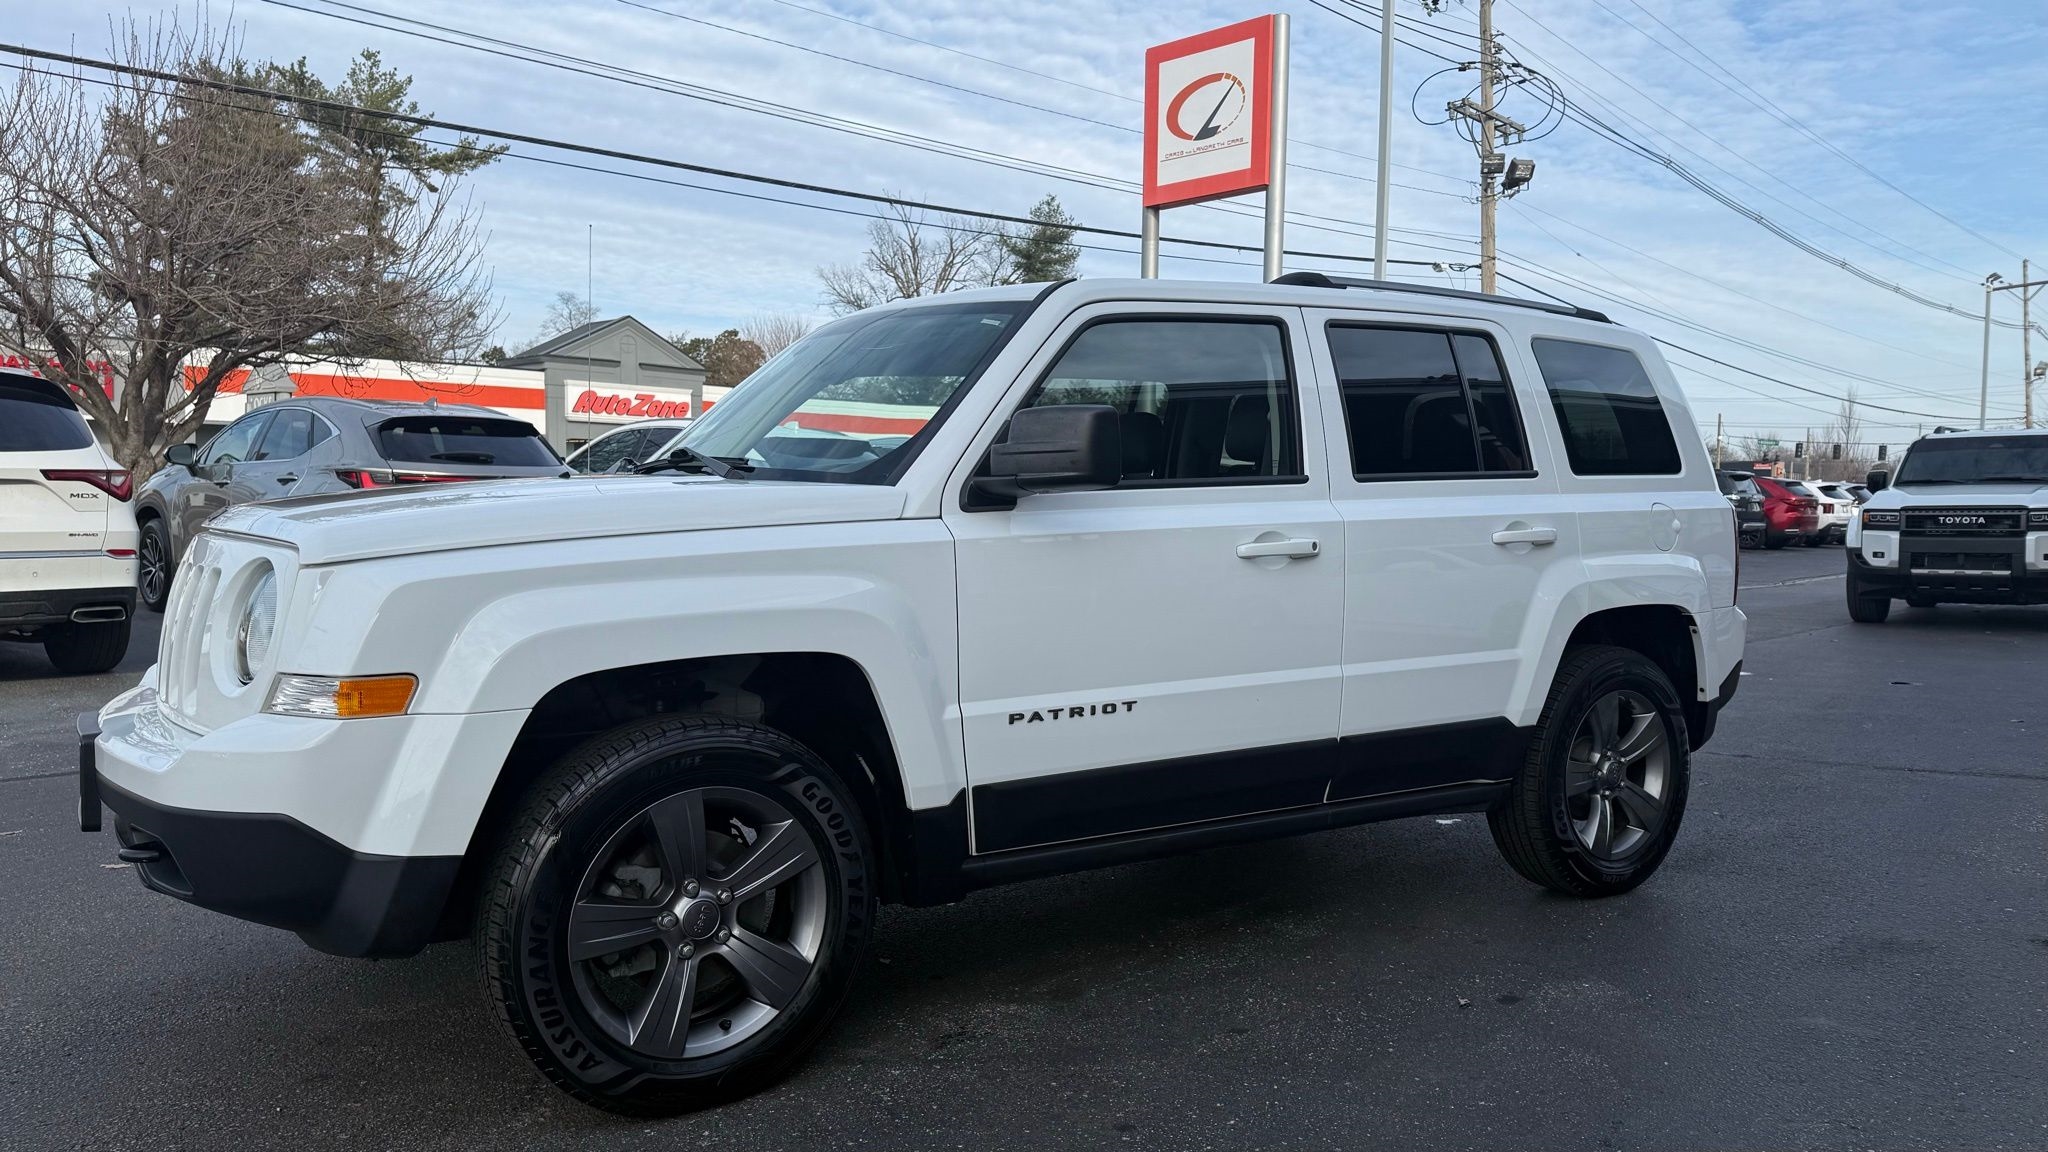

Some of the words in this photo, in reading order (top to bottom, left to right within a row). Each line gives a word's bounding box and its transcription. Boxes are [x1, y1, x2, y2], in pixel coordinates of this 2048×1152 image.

[1226, 137, 1244, 145] CARS
[572, 390, 690, 418] AutoZone
[1938, 516, 1986, 524] TOYOTA
[1008, 700, 1138, 725] PATRIOT
